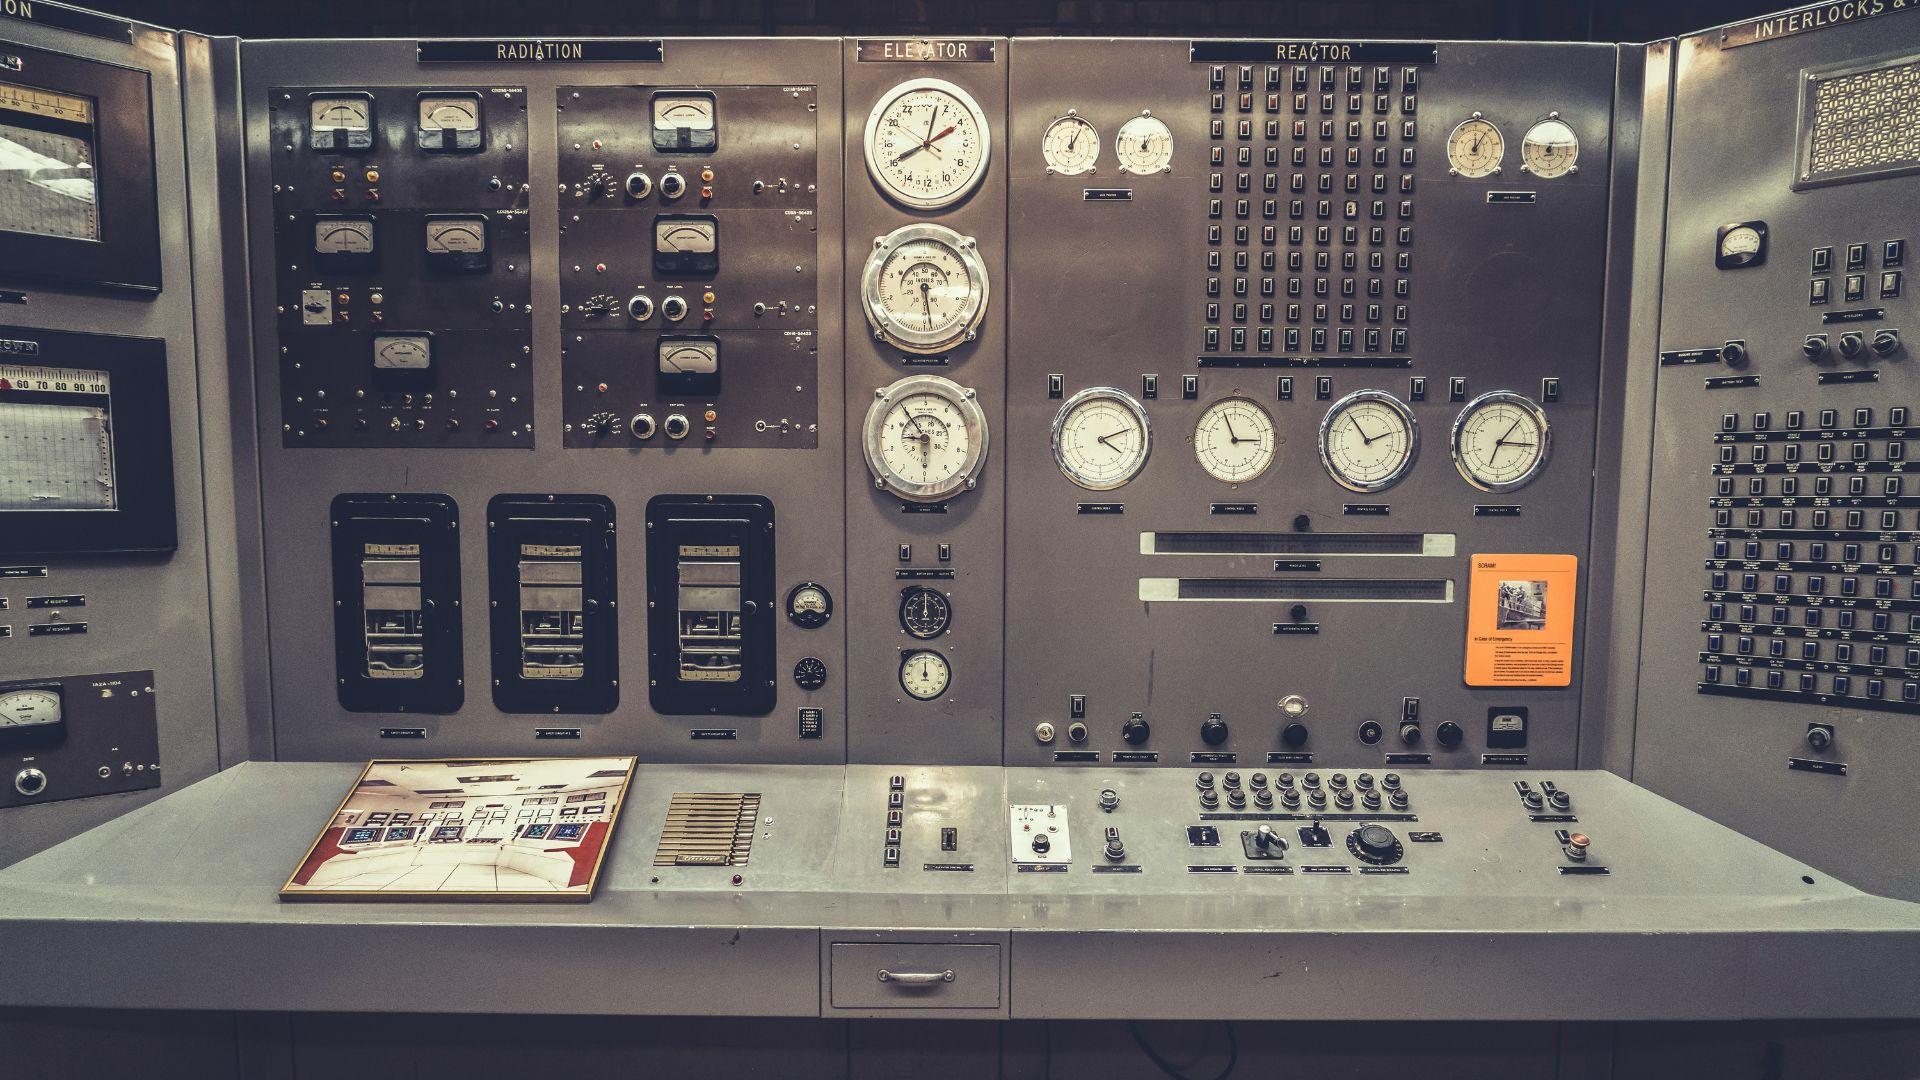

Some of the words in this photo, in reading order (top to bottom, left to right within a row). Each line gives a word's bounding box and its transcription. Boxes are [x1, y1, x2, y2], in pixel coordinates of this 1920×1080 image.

[1756, 0, 1884, 39] INTERLOCKS
[497, 43, 582, 59] RADIATION
[884, 43, 967, 58] ELEVATOR
[1277, 44, 1351, 60] REACTOR
[902, 105, 912, 113] 22
[890, 159, 899, 167] 16
[904, 174, 913, 182] 14
[942, 173, 950, 182] 10
[923, 179, 931, 187] 12
[0, 342, 34, 351] OWN
[17, 380, 29, 388] 60
[36, 381, 48, 390] 70
[55, 382, 67, 390] 80
[74, 383, 85, 392] 90
[90, 384, 106, 392] 100
